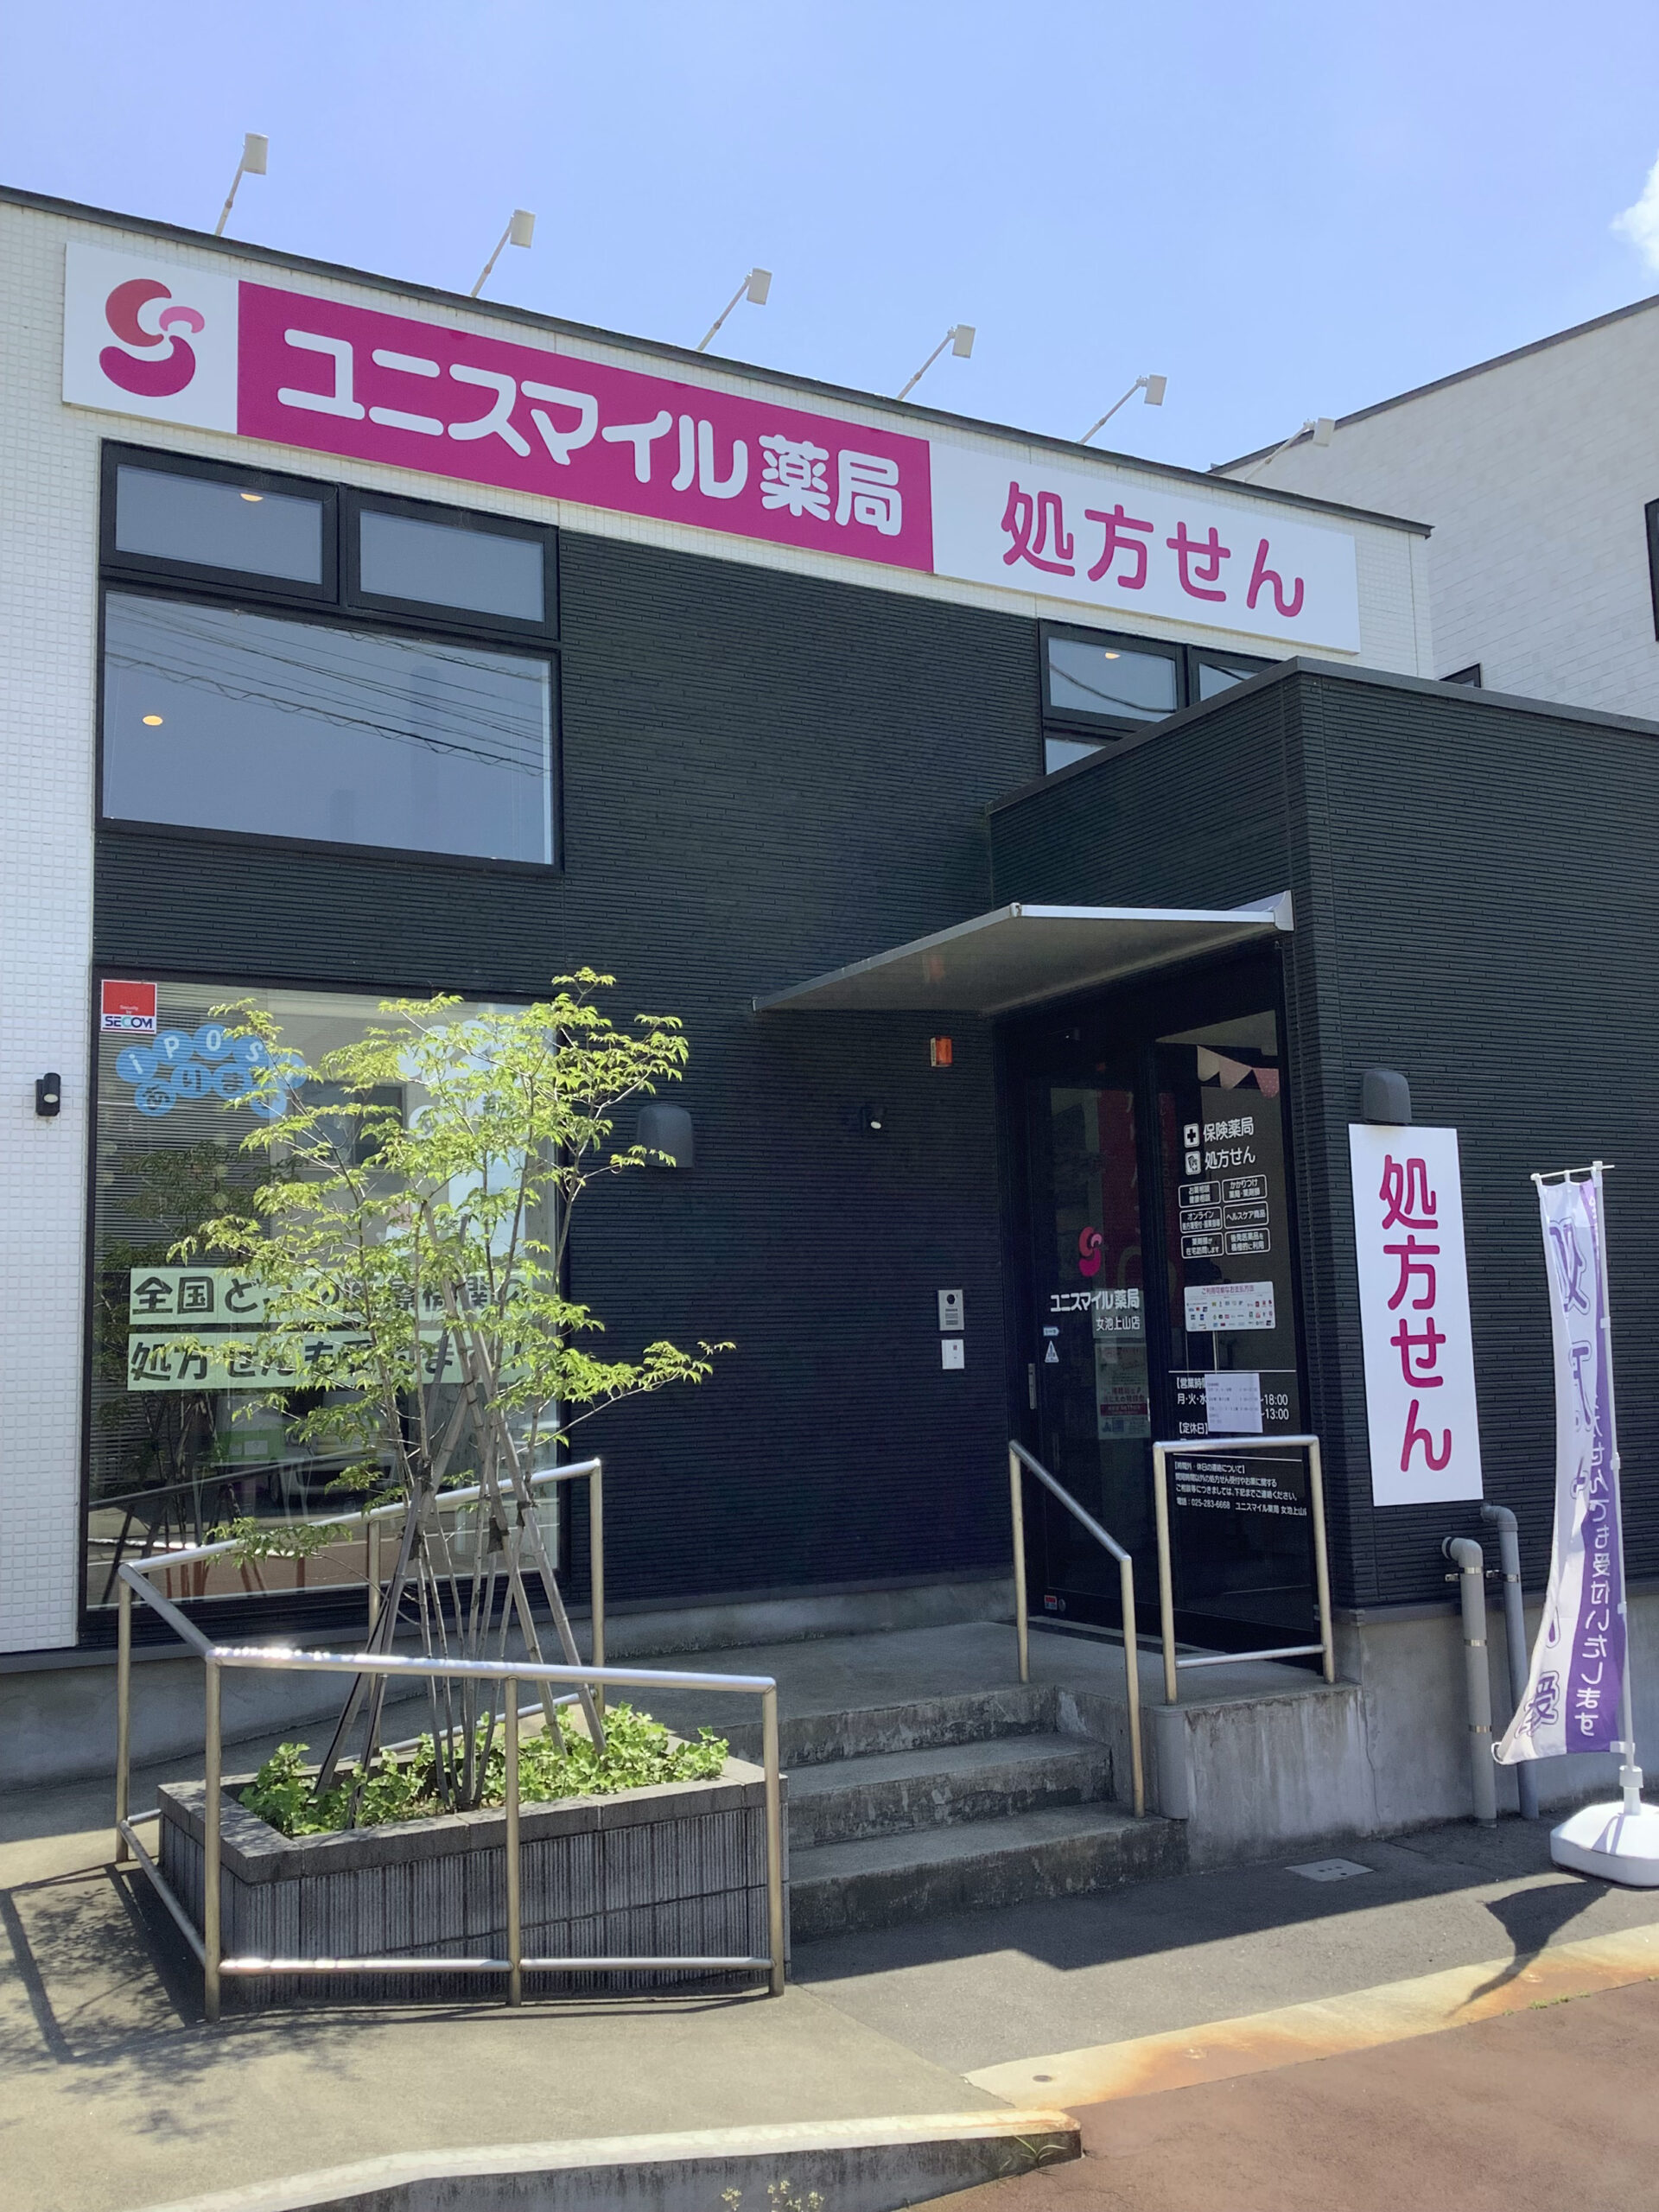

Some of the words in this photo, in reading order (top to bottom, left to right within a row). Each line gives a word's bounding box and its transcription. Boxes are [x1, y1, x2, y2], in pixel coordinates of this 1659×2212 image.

[277, 328, 902, 536] ユニスマイル薬局
[1001, 481, 1305, 617] 処方せん
[105, 1015, 153, 1029] SECOM
[1203, 1116, 1254, 1142] 保険薬局
[1205, 1146, 1255, 1170] 処方せん
[1230, 1179, 1258, 1189] かかりつけ
[1187, 1211, 1214, 1221] オンライン
[1226, 1209, 1266, 1221] ヘルスケア商品
[1051, 1288, 1140, 1312] ユニスマイル薬局
[1096, 1316, 1141, 1332] 女池上山店
[1379, 1154, 1452, 1472] 処方せん
